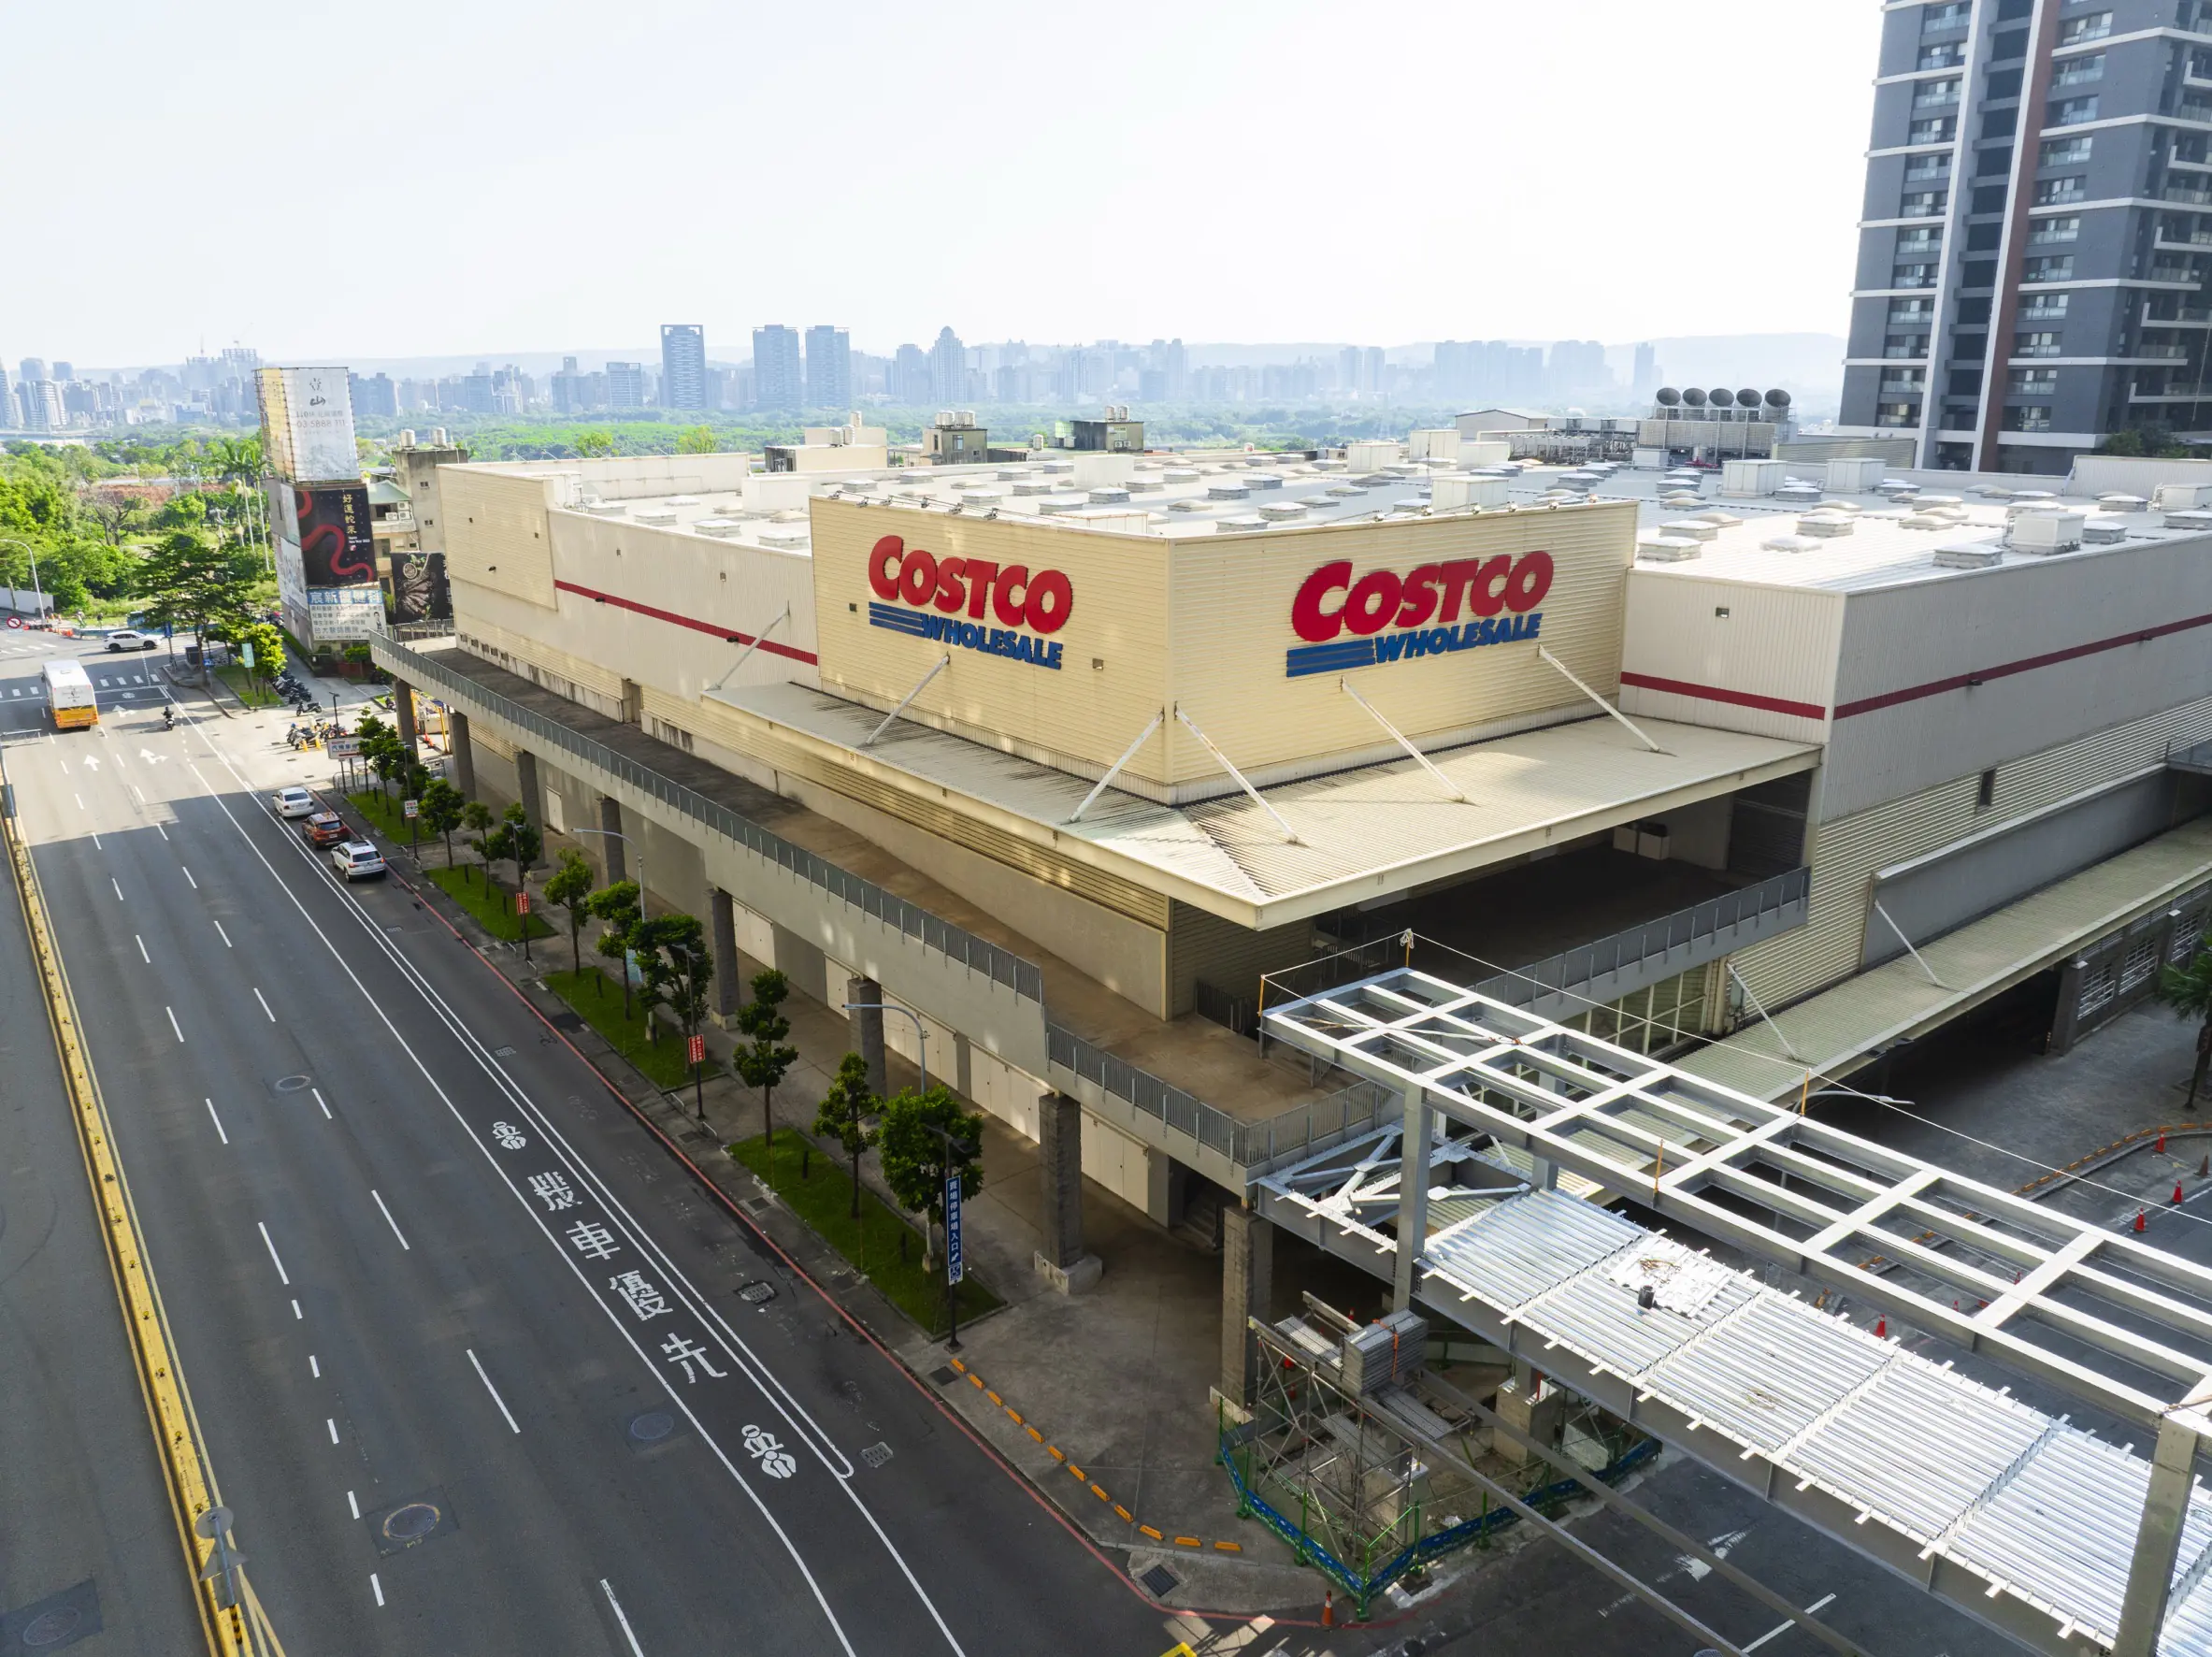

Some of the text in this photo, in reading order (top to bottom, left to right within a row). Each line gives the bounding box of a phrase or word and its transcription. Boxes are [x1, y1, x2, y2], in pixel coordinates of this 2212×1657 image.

[869, 535, 1073, 634] COSTCO
[1292, 550, 1554, 642] COSTCO
[921, 613, 1064, 670] WHOLESALE
[1374, 612, 1544, 663] WHOLESALE
